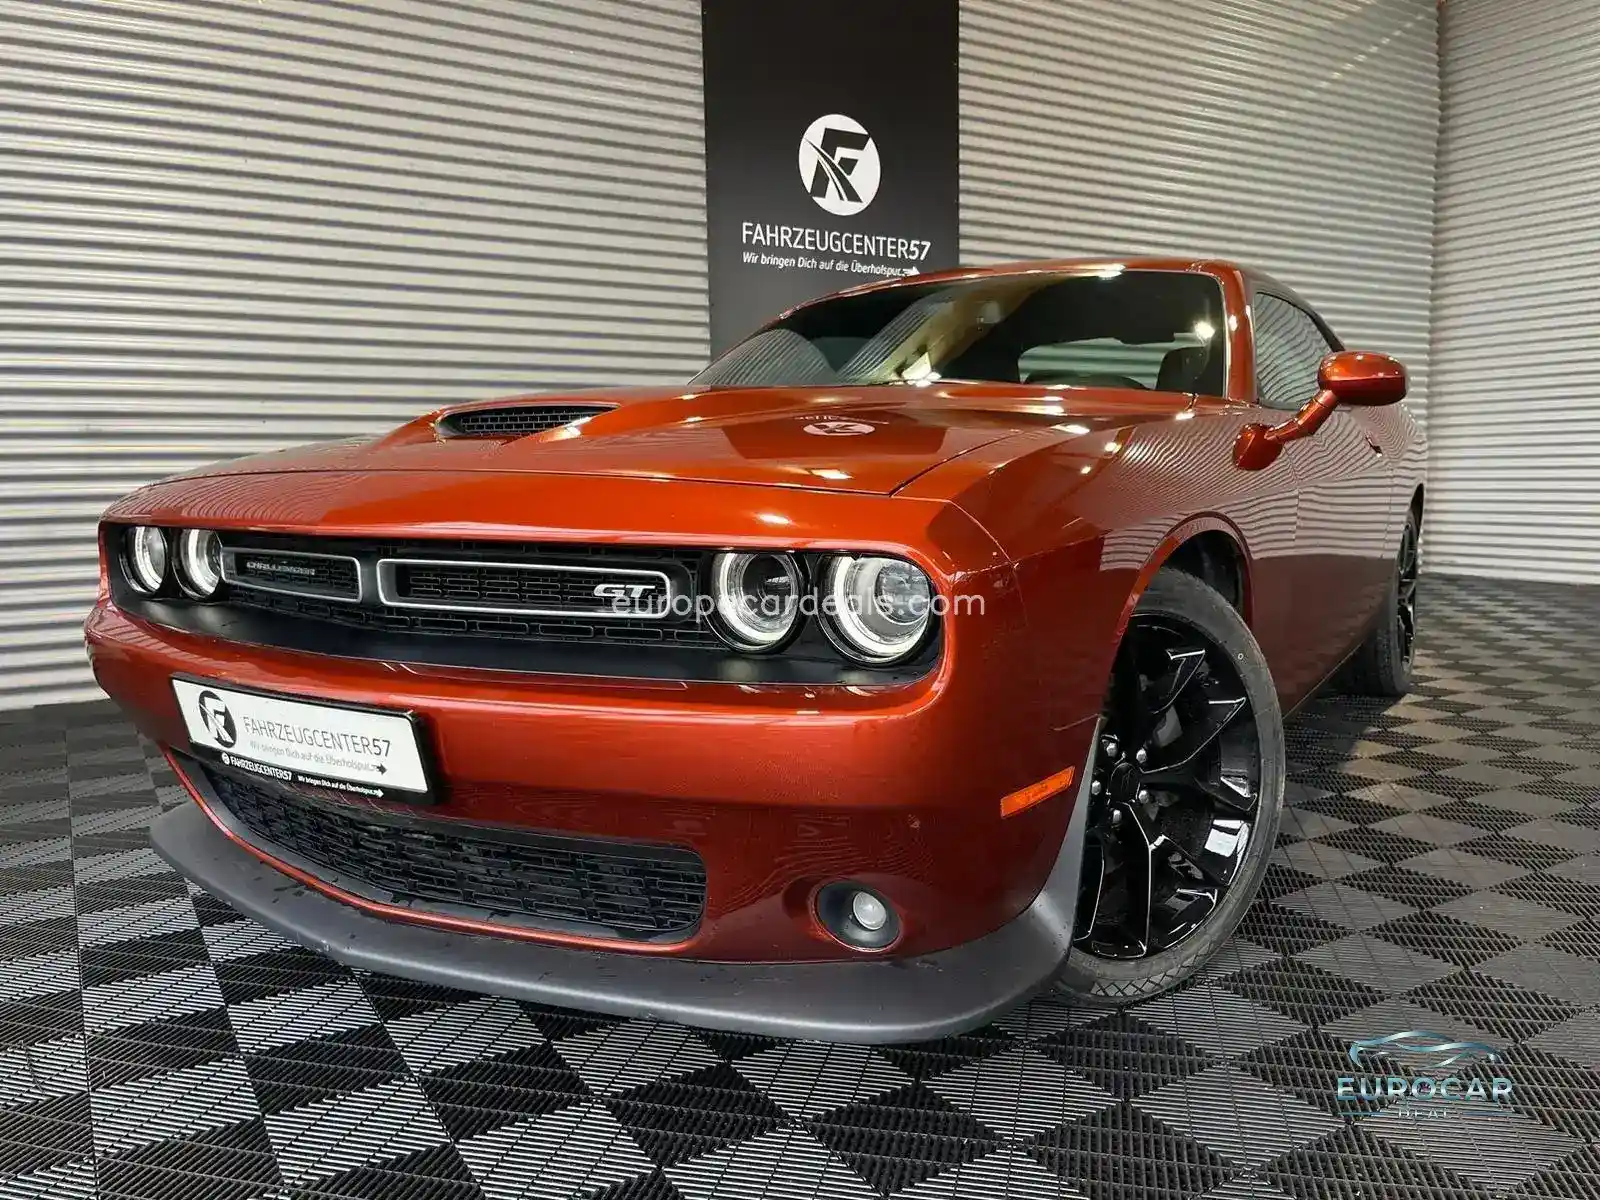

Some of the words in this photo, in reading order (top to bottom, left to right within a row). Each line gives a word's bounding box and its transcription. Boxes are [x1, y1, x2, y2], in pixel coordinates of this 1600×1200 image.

[741, 221, 931, 261] FAHRZEUGCENTER57
[742, 251, 759, 264] Wir
[760, 253, 796, 269] bringen
[797, 256, 817, 269] Dich
[819, 259, 834, 271] auf
[835, 260, 850, 272] die
[593, 583, 656, 599] GT
[242, 715, 391, 758] FAHRZEUGCENTER57
[230, 755, 292, 781] FAHRZEUGCENTER57
